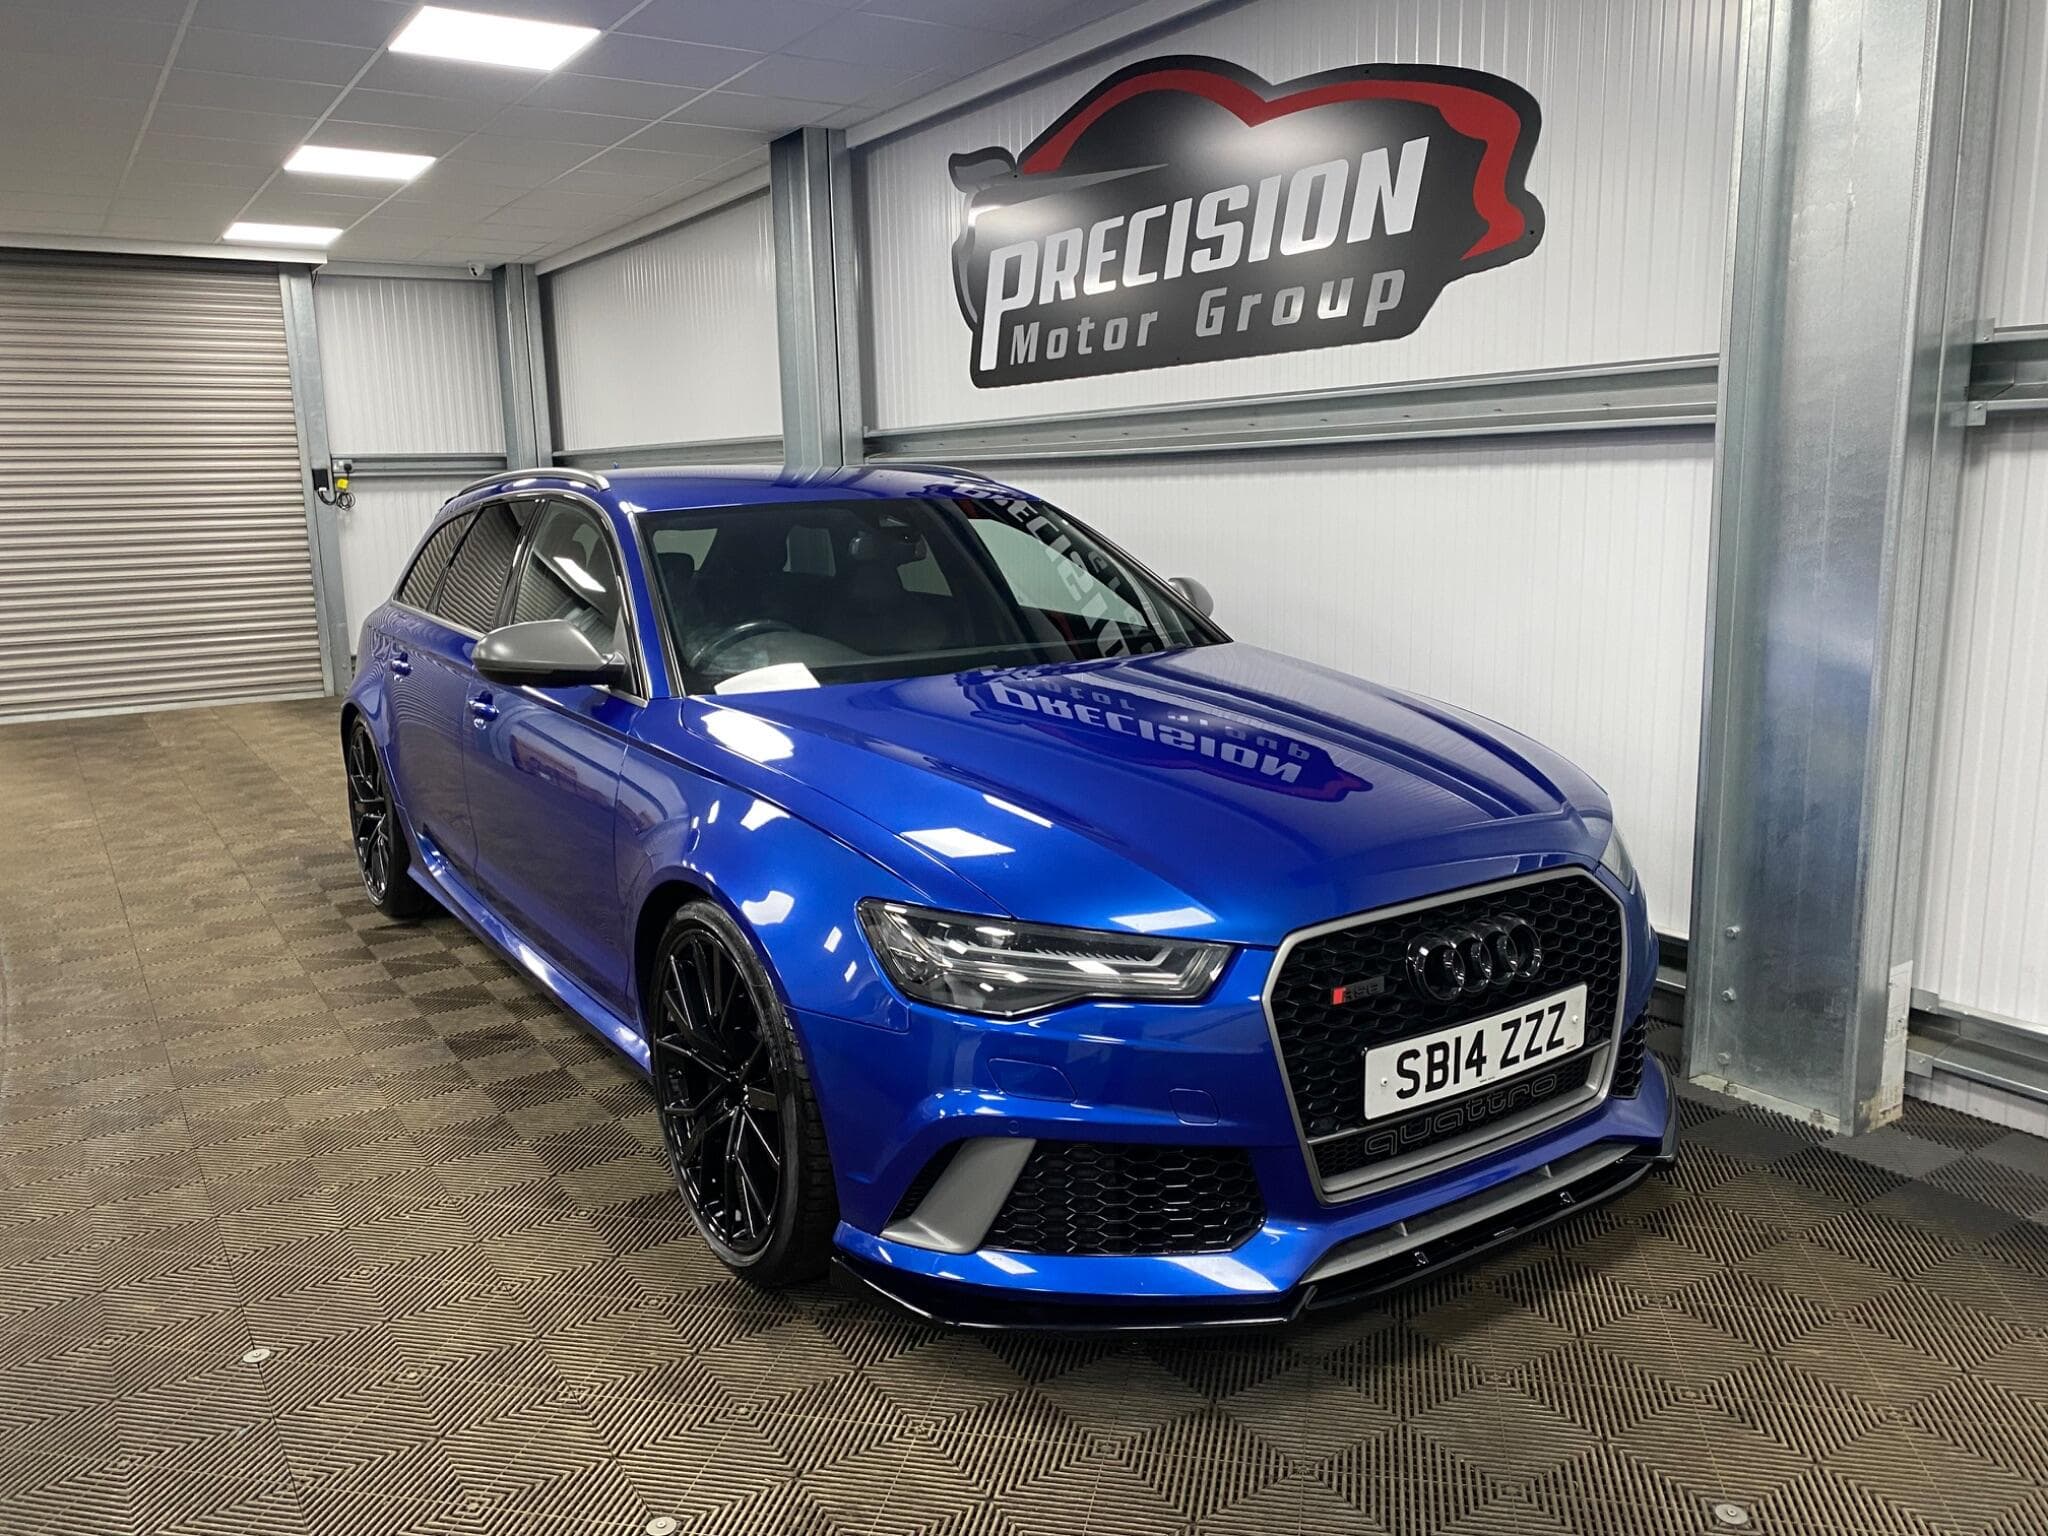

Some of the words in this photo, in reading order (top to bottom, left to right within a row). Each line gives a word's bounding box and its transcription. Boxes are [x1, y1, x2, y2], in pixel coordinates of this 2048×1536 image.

[980, 136, 1429, 371] PRECISION
[1010, 308, 1158, 366] Motor
[1195, 269, 1405, 337] Group
[1396, 1030, 1487, 1100] SB14
[1500, 1001, 1567, 1070] ZZZ
[1365, 1073, 1557, 1156] quattro
